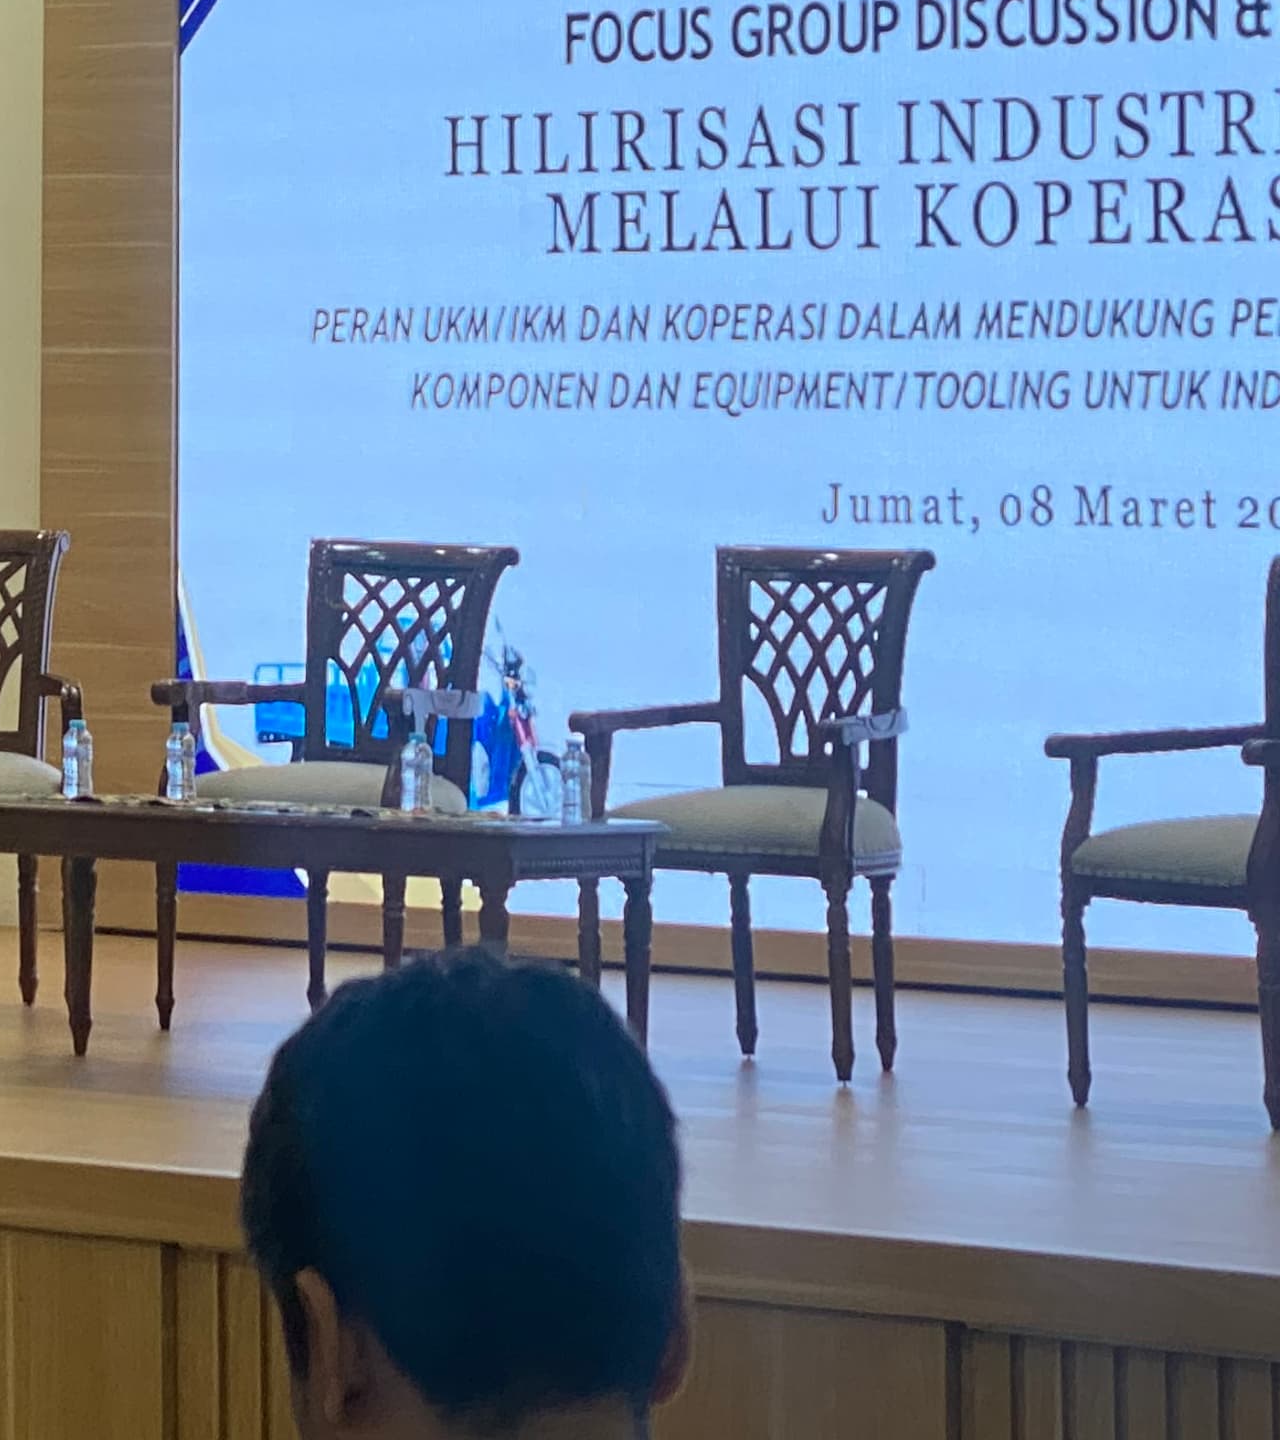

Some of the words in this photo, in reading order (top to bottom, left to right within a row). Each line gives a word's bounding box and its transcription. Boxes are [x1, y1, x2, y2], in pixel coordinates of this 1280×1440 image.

[565, 6, 714, 65] FOCUS
[444, 103, 861, 175] HILIRISASI
[899, 88, 1280, 165] INDUSTR
[546, 187, 880, 253] MELALUI
[311, 304, 414, 345] PERAN
[423, 303, 567, 343] UKM/IKM
[580, 302, 648, 341] DAN
[661, 301, 826, 342] KOPERASI
[837, 300, 962, 340] DALAM
[974, 297, 1215, 340] MENDUKUNG
[1229, 296, 1280, 337] PE
[409, 371, 597, 411] KOMPONEN
[608, 371, 680, 410] DAN
[692, 369, 1071, 418] EQUIPMENT/TOOLING
[1084, 369, 1209, 410] UNTUK
[1074, 484, 1217, 529] Maret
